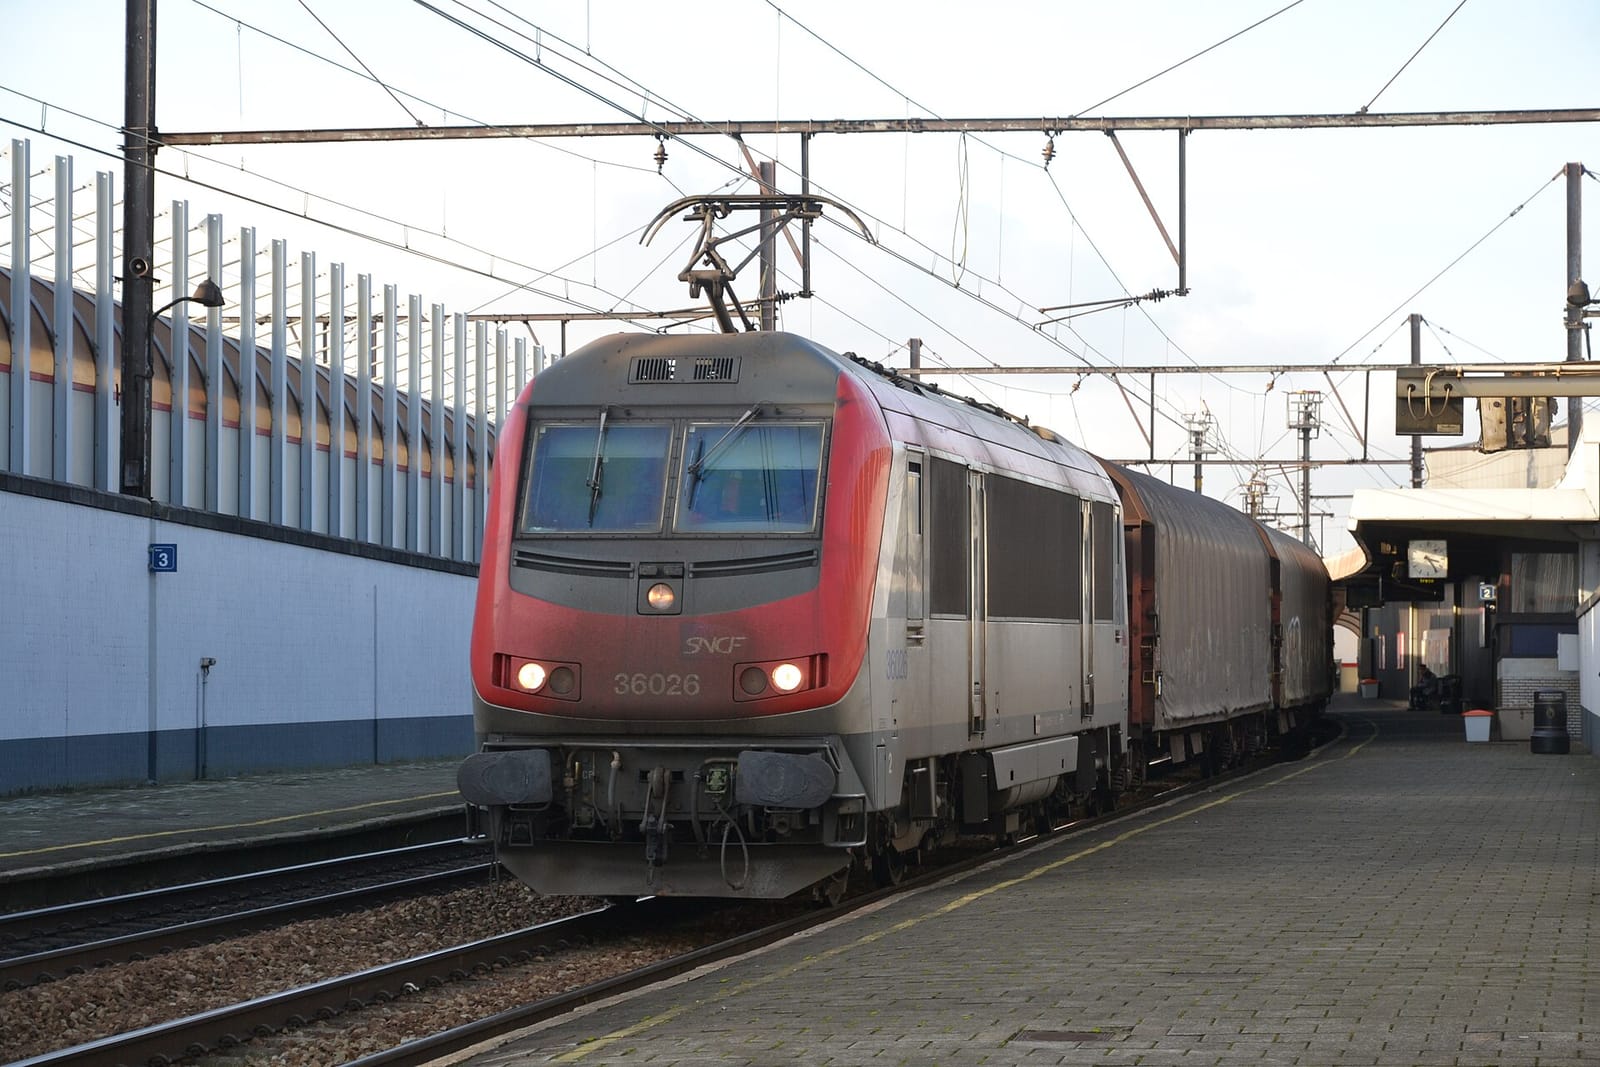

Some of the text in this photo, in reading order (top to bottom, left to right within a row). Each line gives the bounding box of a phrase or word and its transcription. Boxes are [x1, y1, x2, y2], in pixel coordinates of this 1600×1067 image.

[159, 553, 168, 567] 3
[1483, 589, 1490, 598] 2
[683, 636, 747, 654] SNCF
[614, 672, 700, 696] 36026
